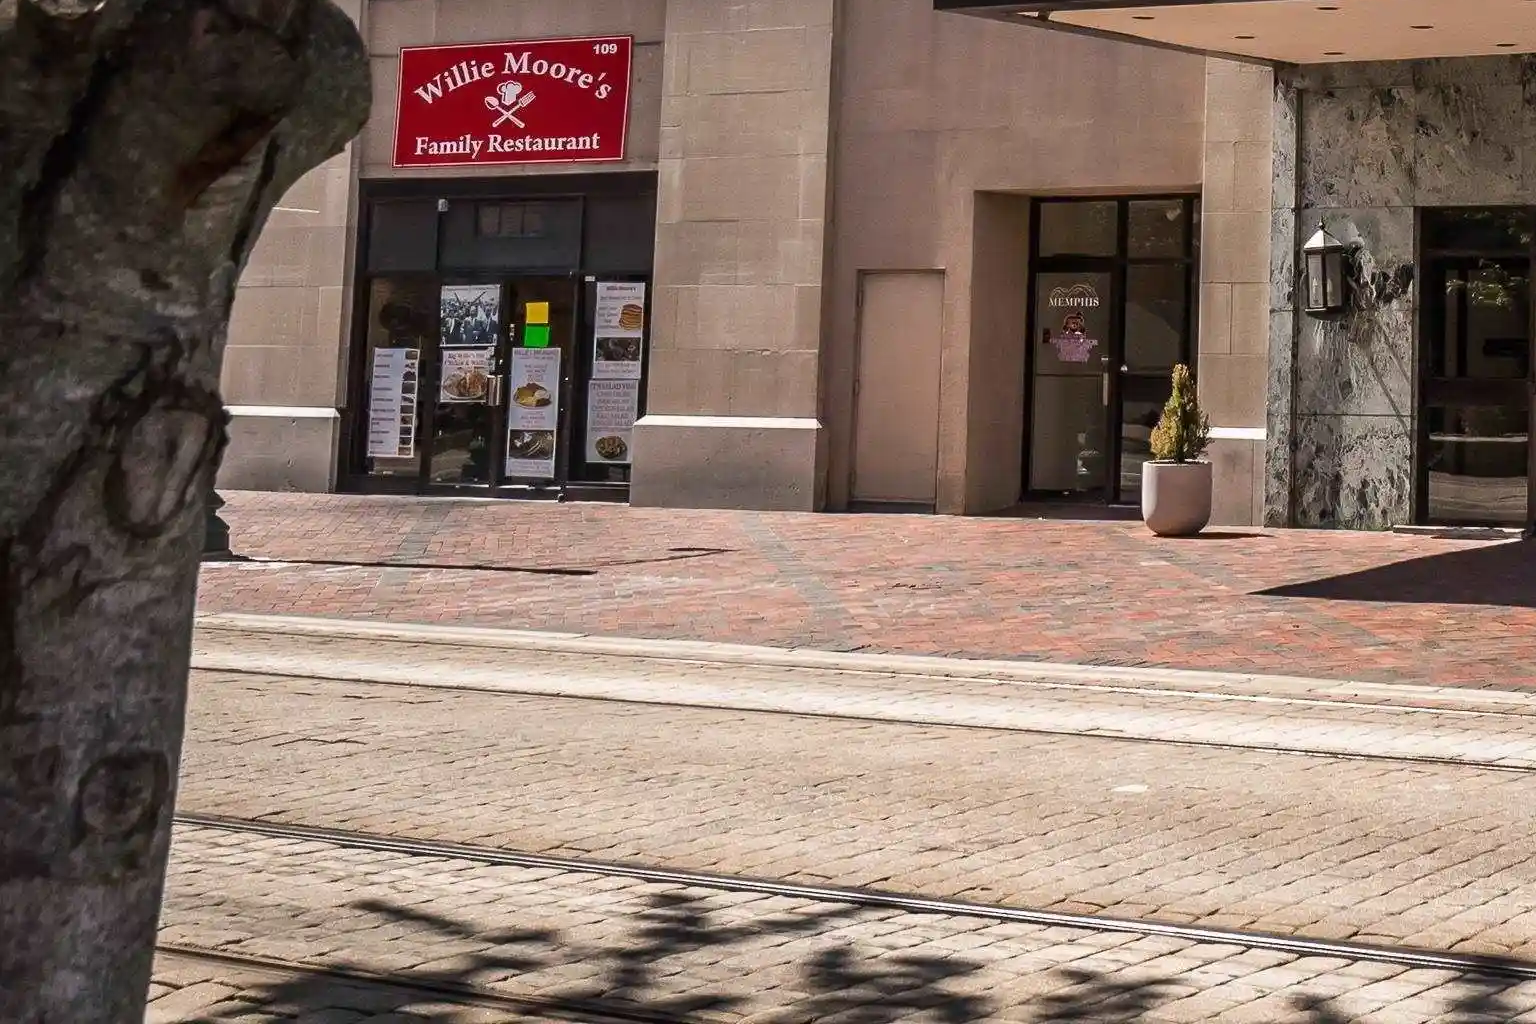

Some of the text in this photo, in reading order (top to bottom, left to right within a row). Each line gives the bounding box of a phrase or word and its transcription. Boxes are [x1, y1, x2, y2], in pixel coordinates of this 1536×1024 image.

[593, 43, 618, 55] 109
[413, 51, 612, 104] Willie Moore's
[415, 132, 601, 159] Family Restaurant
[1048, 297, 1100, 307] MEMPHIS
